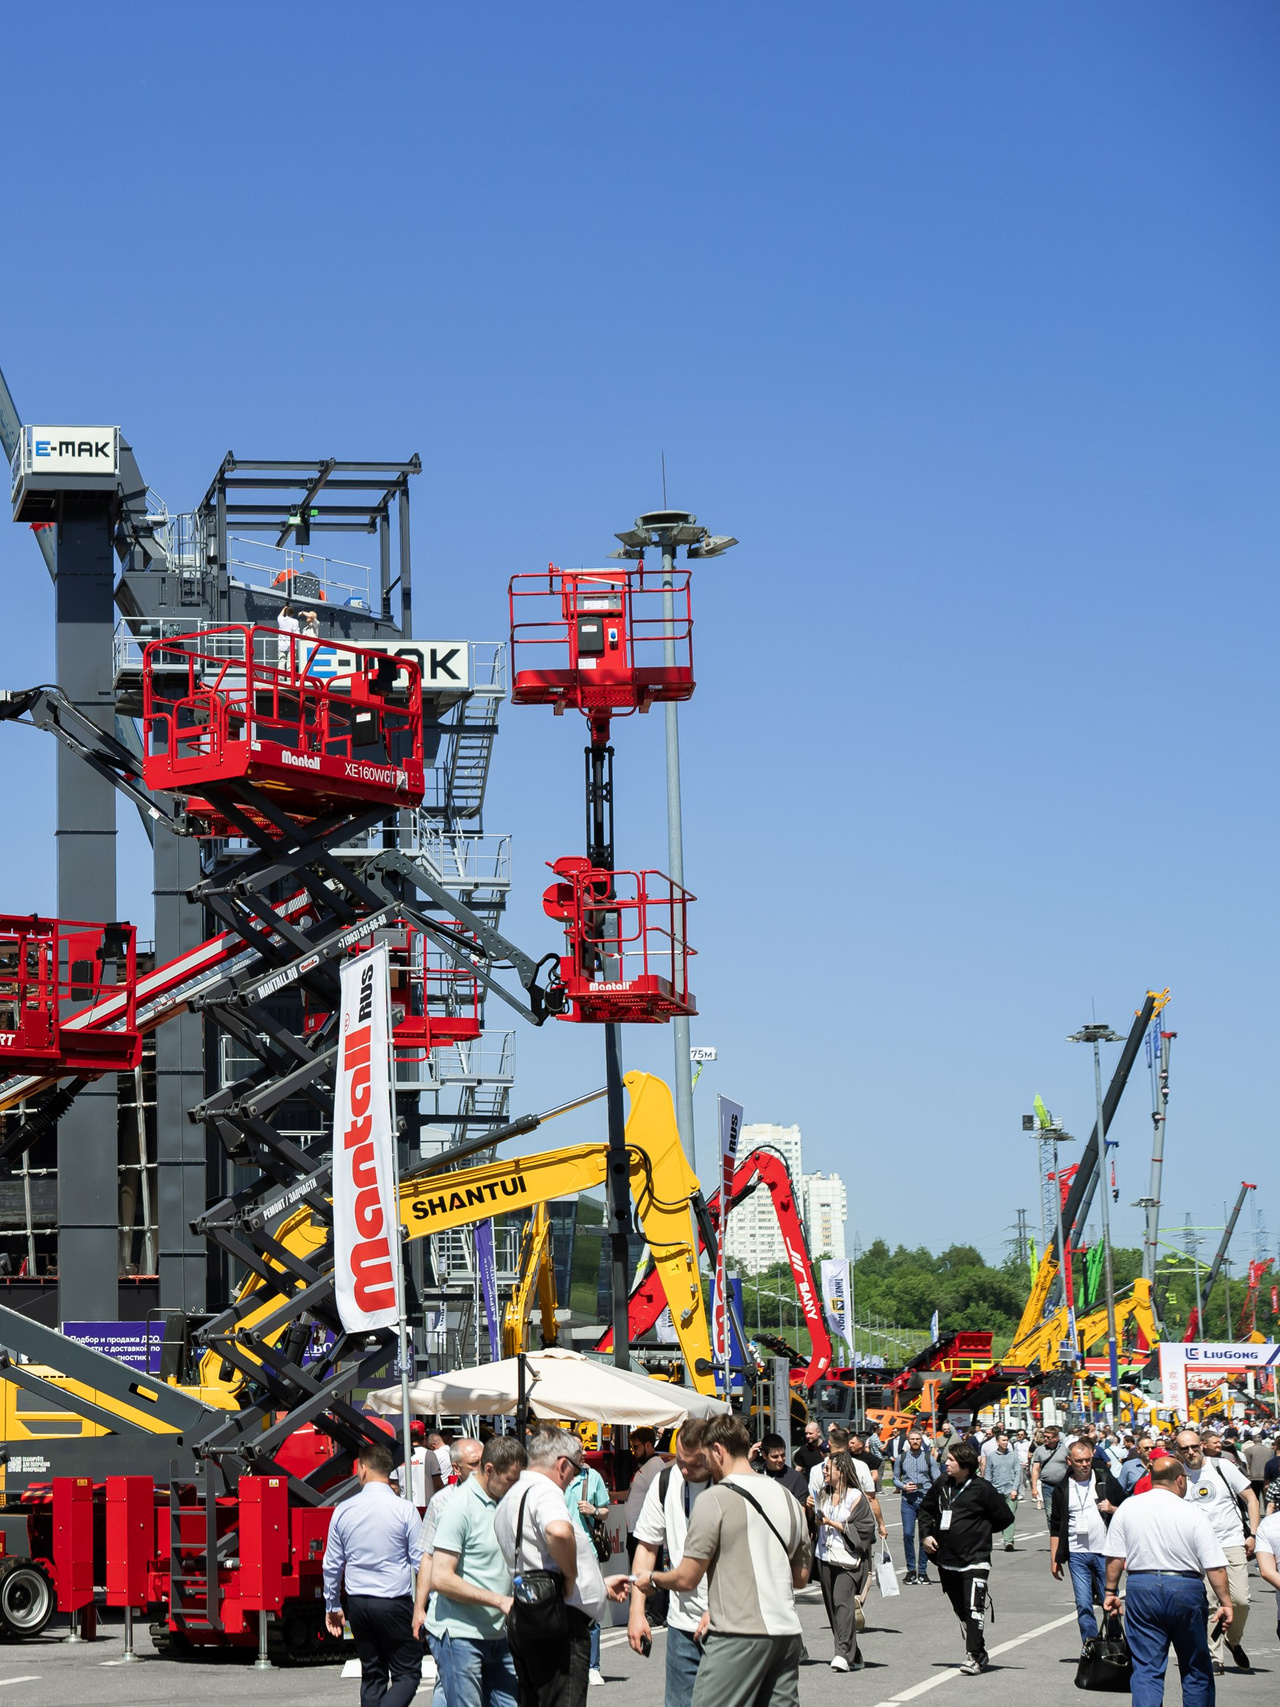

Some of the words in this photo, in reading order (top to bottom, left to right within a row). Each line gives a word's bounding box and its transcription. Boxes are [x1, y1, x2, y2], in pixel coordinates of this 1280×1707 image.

[35, 440, 111, 458] E-MAK
[306, 646, 462, 681] E-AK
[281, 749, 321, 771] Mantall
[337, 938, 346, 949] +7
[257, 966, 299, 1000] MANTALL.RU
[358, 963, 375, 1024] RUS
[588, 981, 632, 992] Mantall
[728, 1113, 739, 1154] RUS
[344, 1025, 396, 1313] Mantall
[262, 1197, 285, 1221] РЕМОНТ
[287, 1177, 318, 1203] ЗАПЧАСТИ
[411, 1175, 527, 1220] SHANTUI
[798, 1282, 819, 1320] SANY
